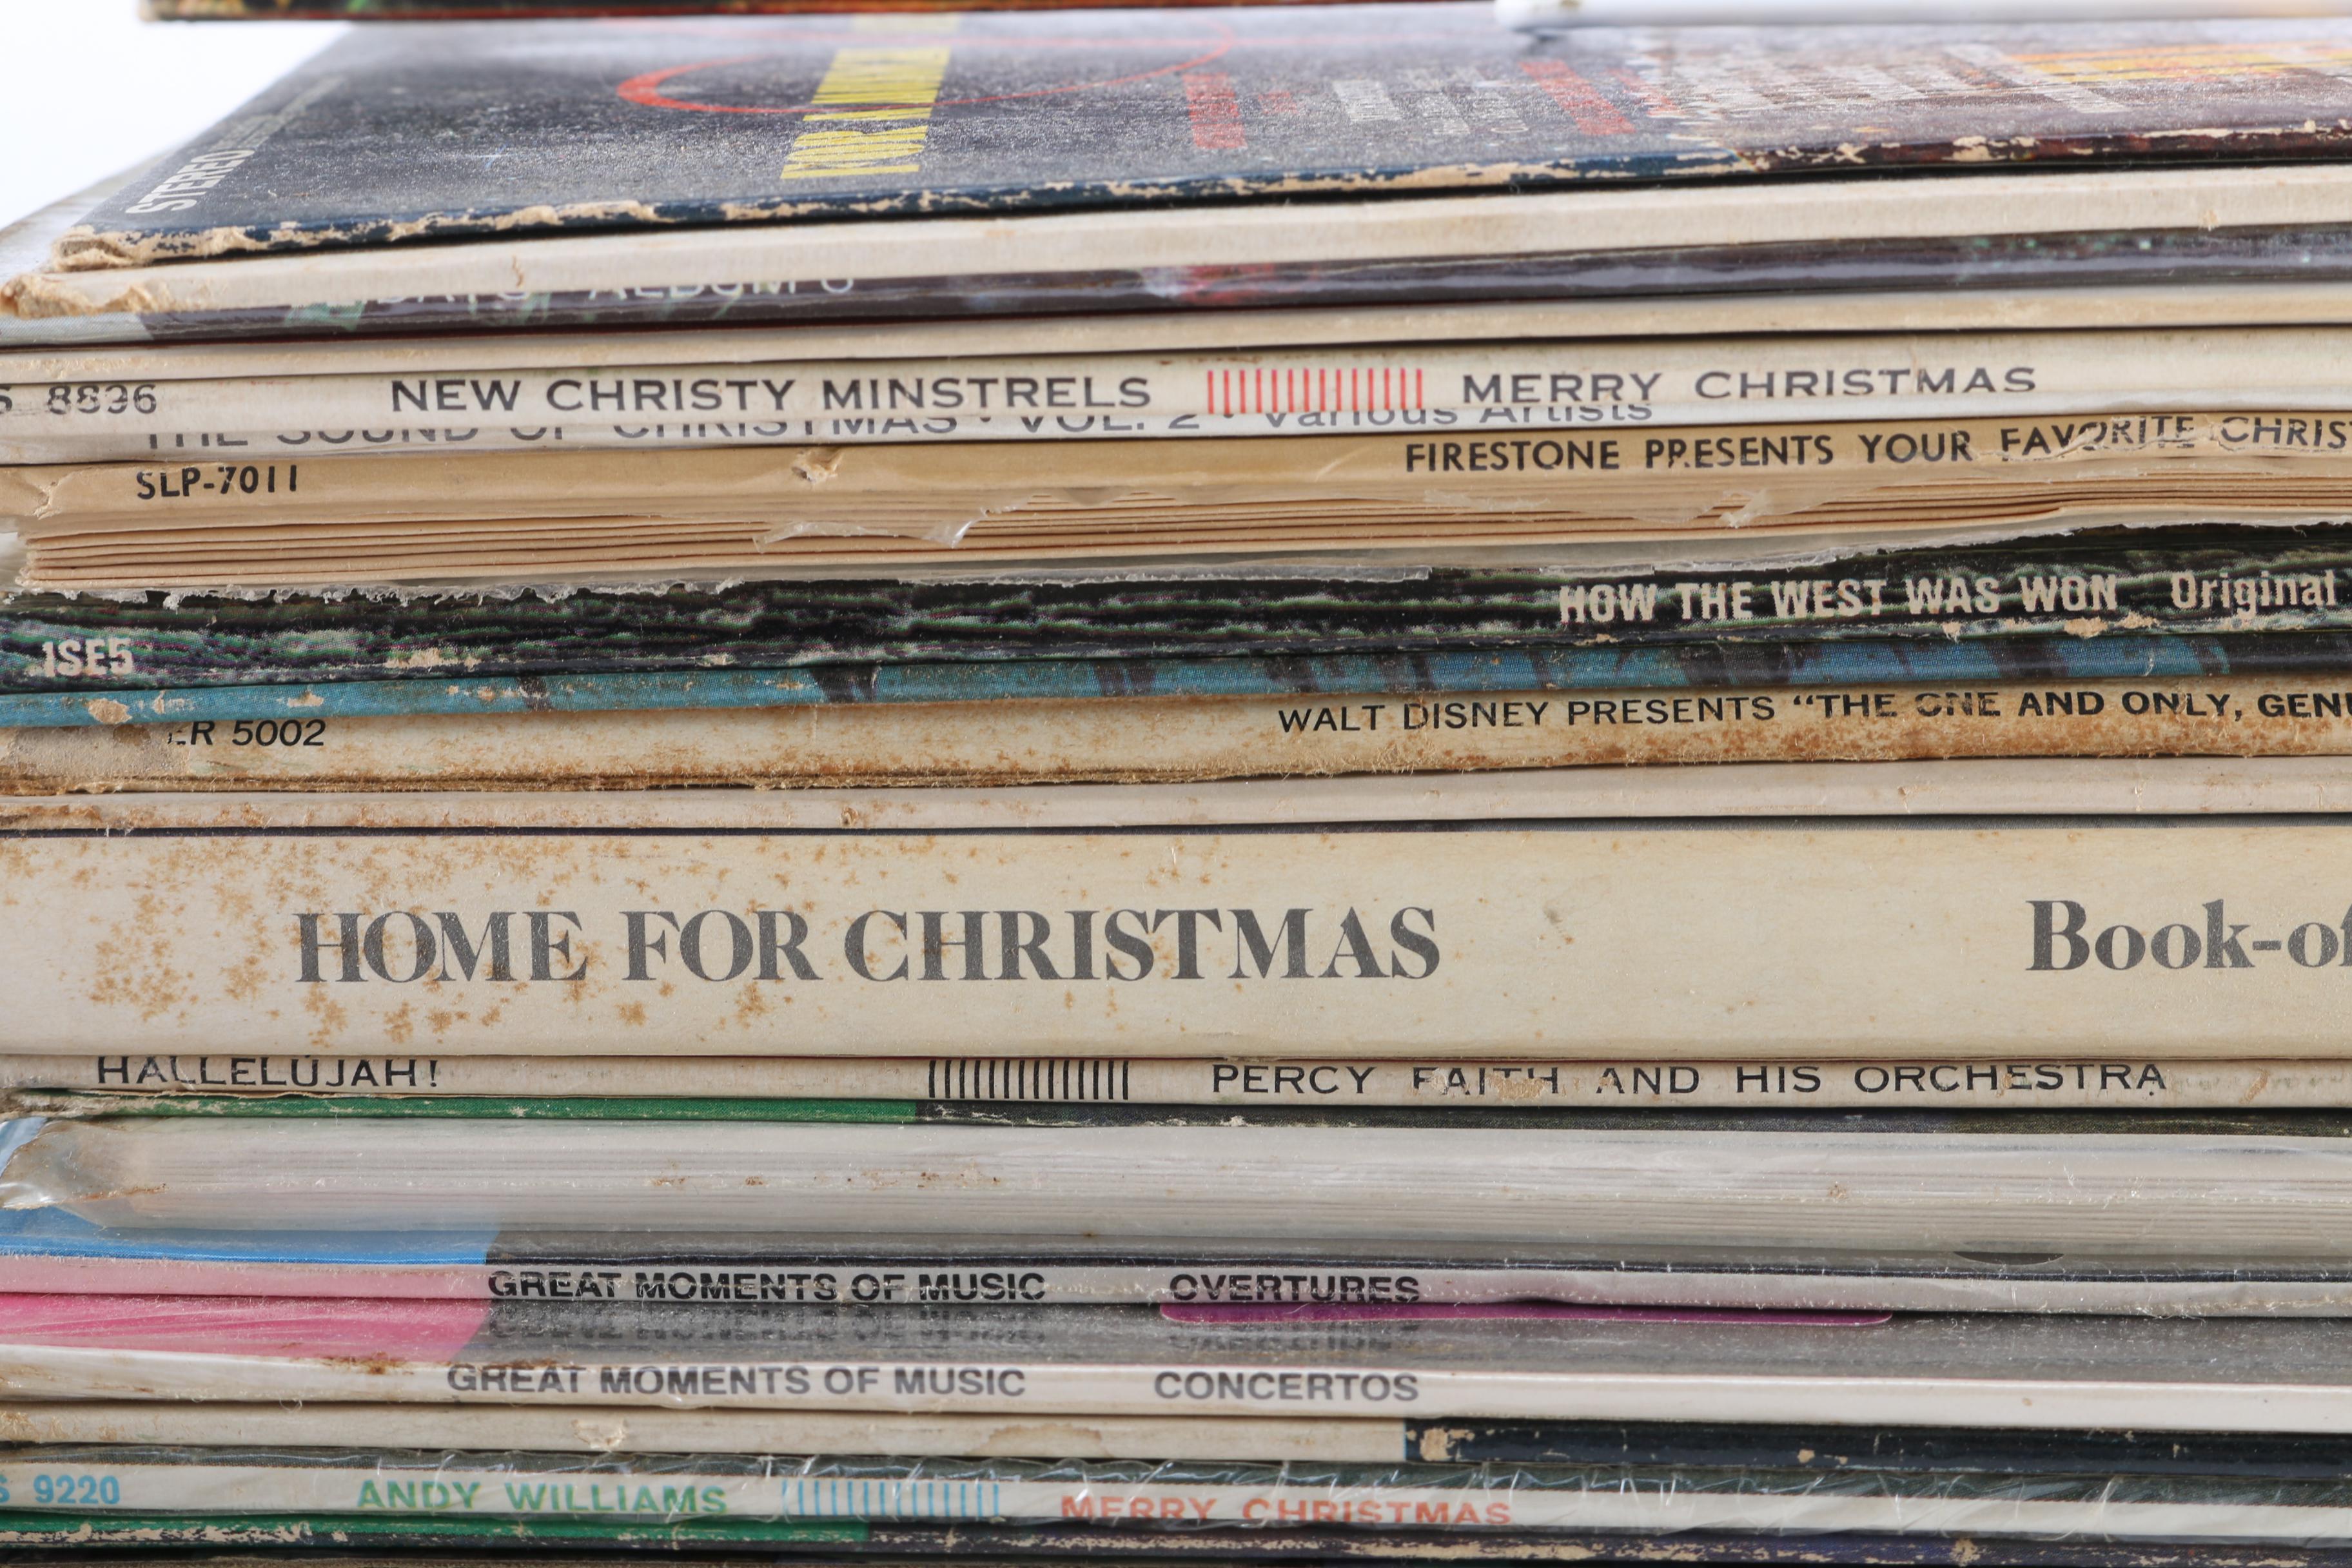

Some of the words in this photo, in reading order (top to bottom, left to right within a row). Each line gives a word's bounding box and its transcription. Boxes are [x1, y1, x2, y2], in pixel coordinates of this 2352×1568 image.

[125, 150, 255, 213] STEREO
[392, 379, 520, 411] NEW
[546, 378, 795, 411] CHRISTY
[823, 377, 1150, 409] MINSTRELS
[1463, 373, 1661, 404] MERRY
[1696, 367, 2036, 399] CHRISTMAS
[1406, 440, 1620, 472] FIRESTONE
[1646, 435, 1834, 469] PRESENTS
[1859, 431, 1973, 464] YOUR
[2001, 415, 2195, 462] FAVORITE
[137, 464, 298, 500] SLP-7011
[1560, 582, 1657, 624] HOW
[1676, 580, 1762, 621] THE
[1773, 577, 1886, 620] WEST
[1904, 574, 2000, 615] WAS
[2019, 573, 2117, 612] WON
[2171, 569, 2337, 620] Original
[1279, 705, 1386, 732] WALT
[1404, 701, 1549, 730] DISNEY
[1569, 696, 1775, 726] PRESENTS
[1915, 692, 2001, 717] ONE
[2018, 692, 2104, 717] AND
[2122, 691, 2242, 721] ONLY,
[2258, 692, 2352, 718] GEN
[232, 719, 326, 746] 5002
[293, 911, 588, 983] HOME
[620, 910, 824, 983] FOR
[845, 907, 1440, 982] CHRISTMAS
[97, 1055, 438, 1088] HALLELUJAH!
[1213, 1064, 1377, 1094] PERCY
[1413, 1066, 1559, 1095] FAITH
[1596, 1065, 1700, 1095] AND
[1736, 1064, 1821, 1093] HIS
[488, 1270, 622, 1298] GREAT
[635, 1272, 838, 1300] MOMENTS
[850, 1273, 906, 1301] OF
[920, 1273, 1047, 1301] MUSIC
[1170, 1274, 1420, 1303] OVERTURES
[447, 1364, 586, 1393] GREAT
[600, 1366, 810, 1395] MOMENTS
[825, 1367, 879, 1395] OF
[895, 1368, 1025, 1396] MUSIC
[1155, 1371, 1420, 1401] CONCERTOS
[34, 1475, 121, 1504] 9220
[358, 1480, 481, 1509] ANDY
[508, 1484, 727, 1514] WILLIAMS
[1061, 1496, 1217, 1520] MERRY
[1242, 1498, 1511, 1525] CHRISTMAS
